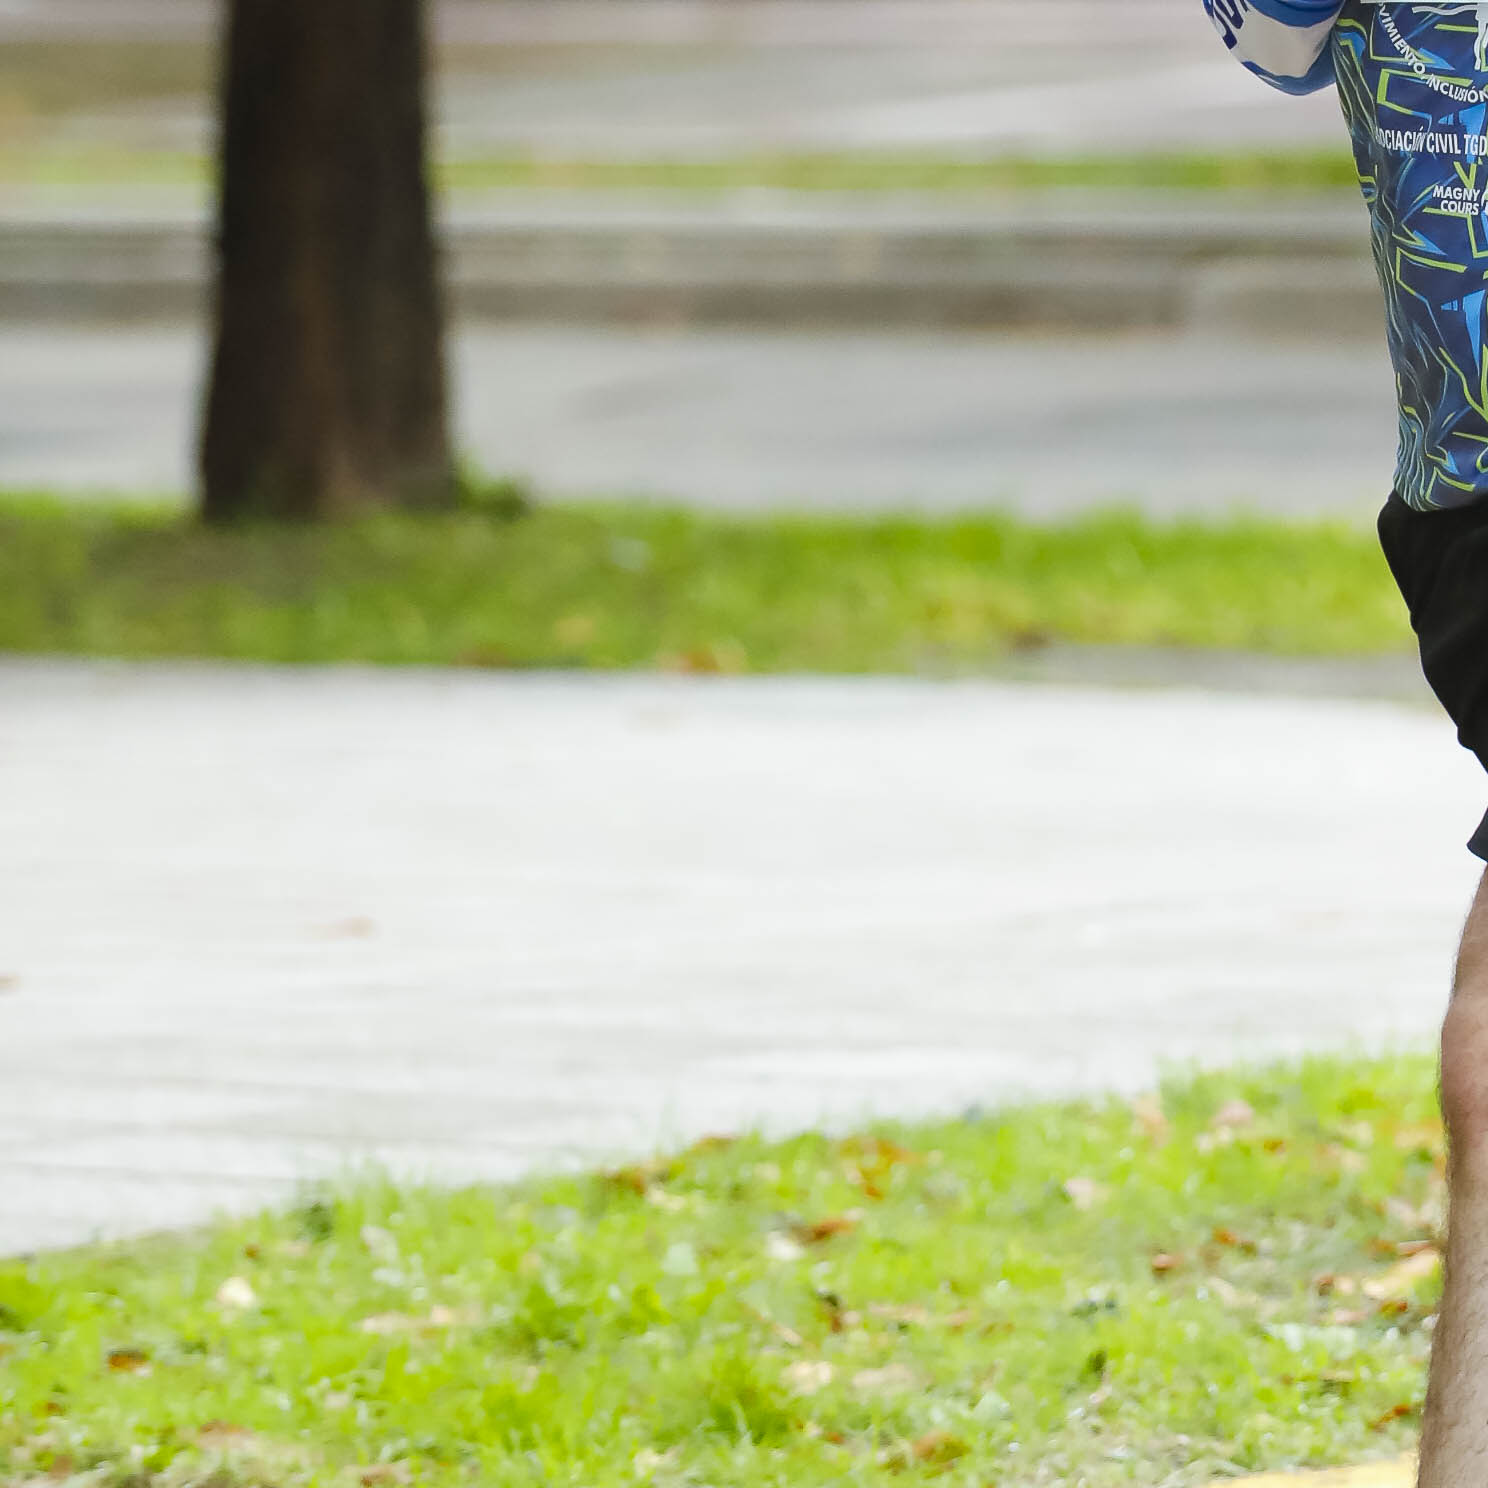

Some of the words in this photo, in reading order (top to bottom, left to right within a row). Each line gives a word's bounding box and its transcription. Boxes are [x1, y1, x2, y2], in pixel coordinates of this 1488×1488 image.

[1427, 132, 1461, 155] CIVIL
[1464, 134, 1488, 157] TGD
[1433, 185, 1480, 202] MAGNY
[1441, 200, 1480, 216] COURS
